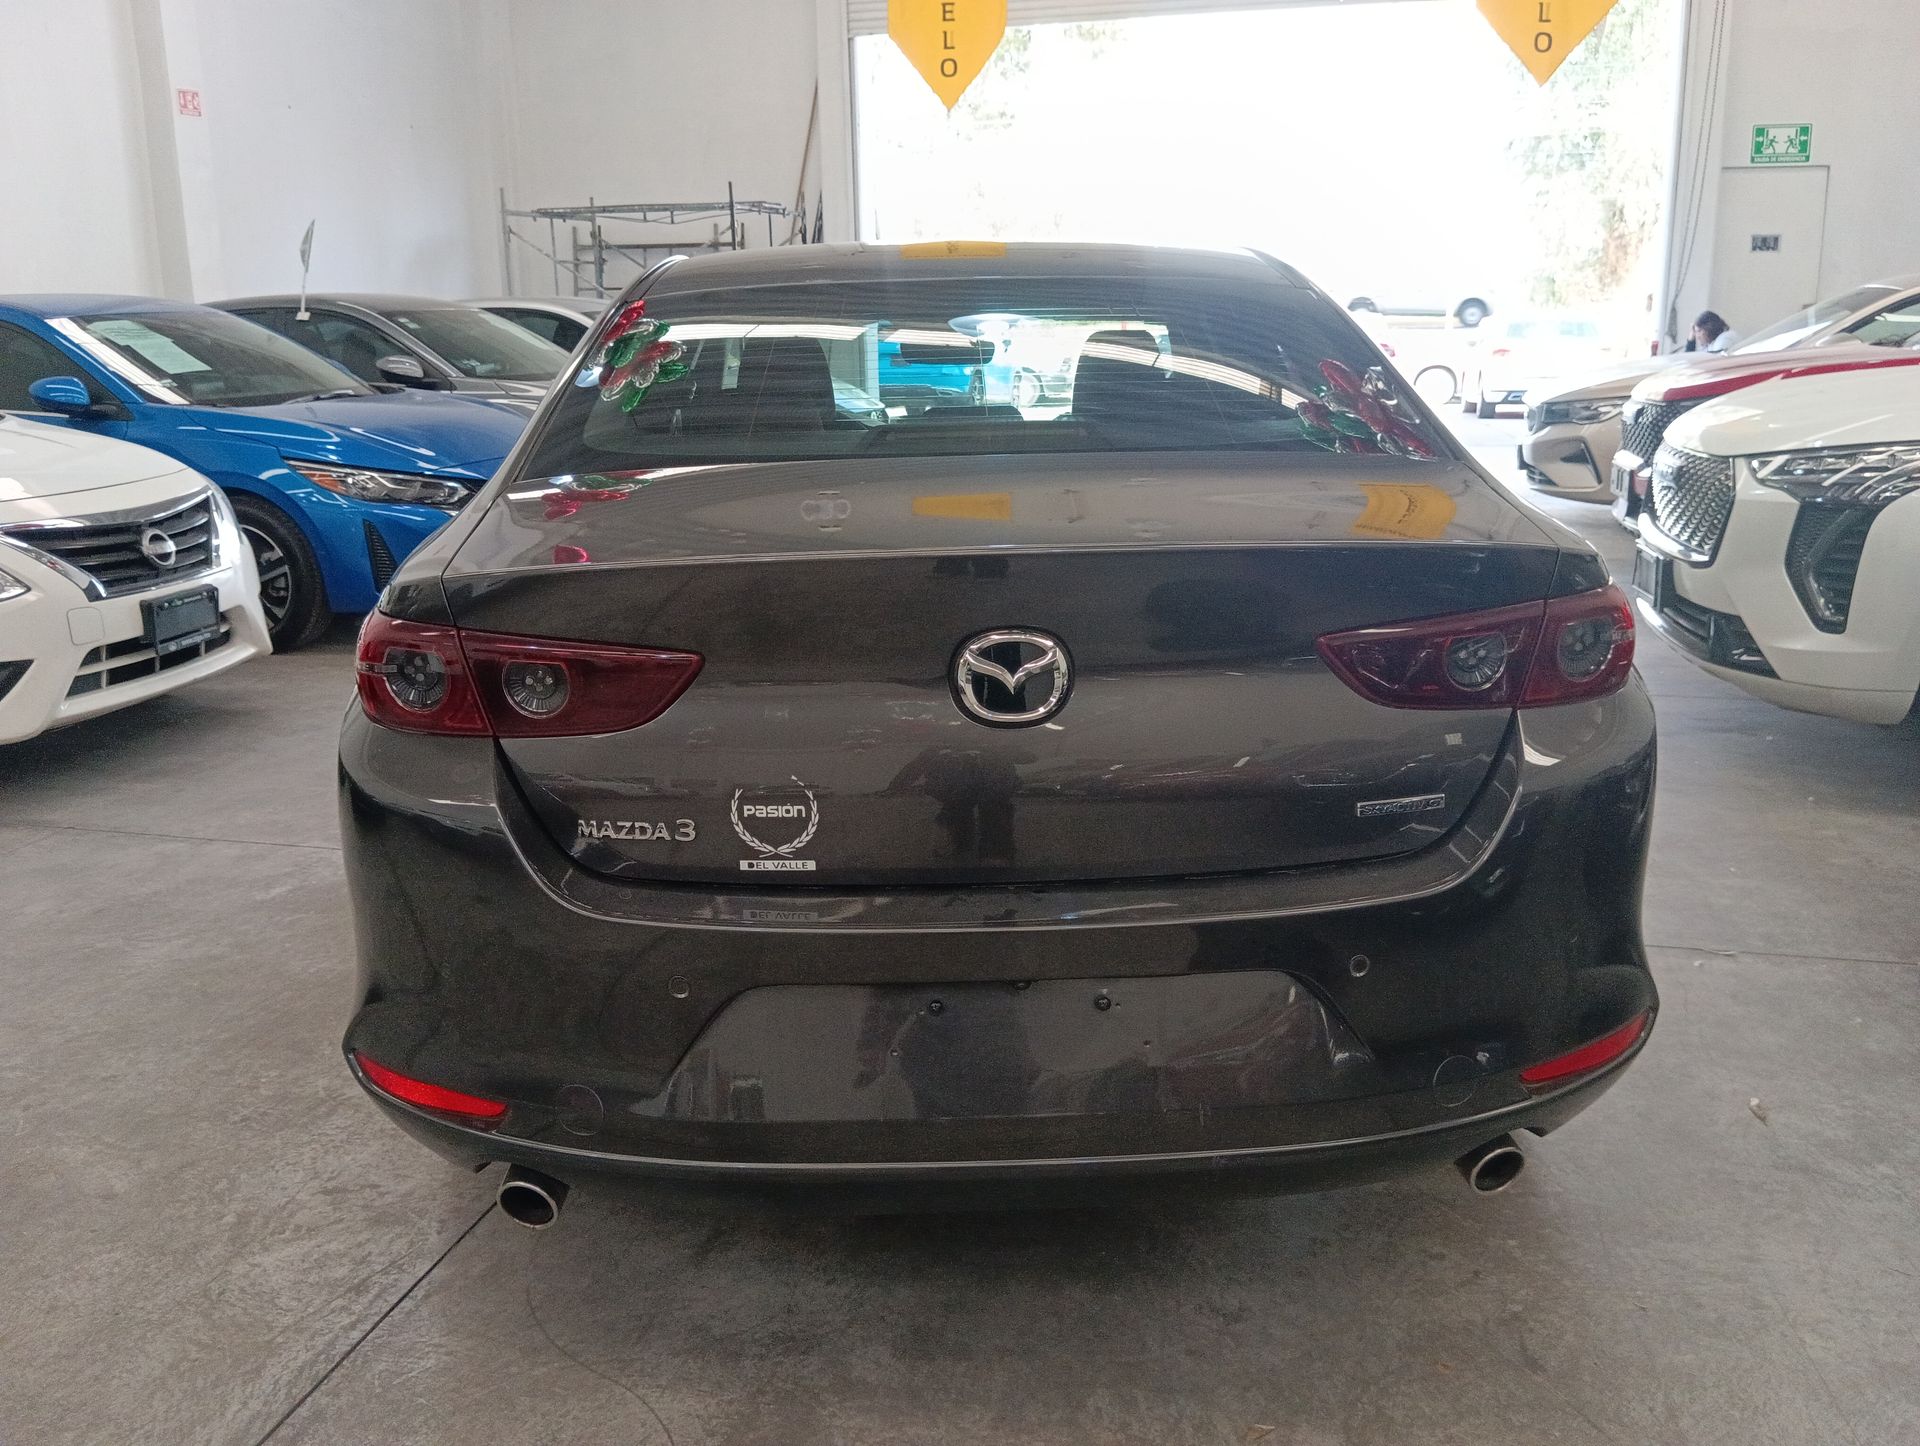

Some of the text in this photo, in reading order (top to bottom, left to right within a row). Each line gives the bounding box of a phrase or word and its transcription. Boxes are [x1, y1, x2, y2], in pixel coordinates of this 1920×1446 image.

[578, 818, 696, 842] MAZDA 3
[747, 861, 809, 870] DEL VALLE
